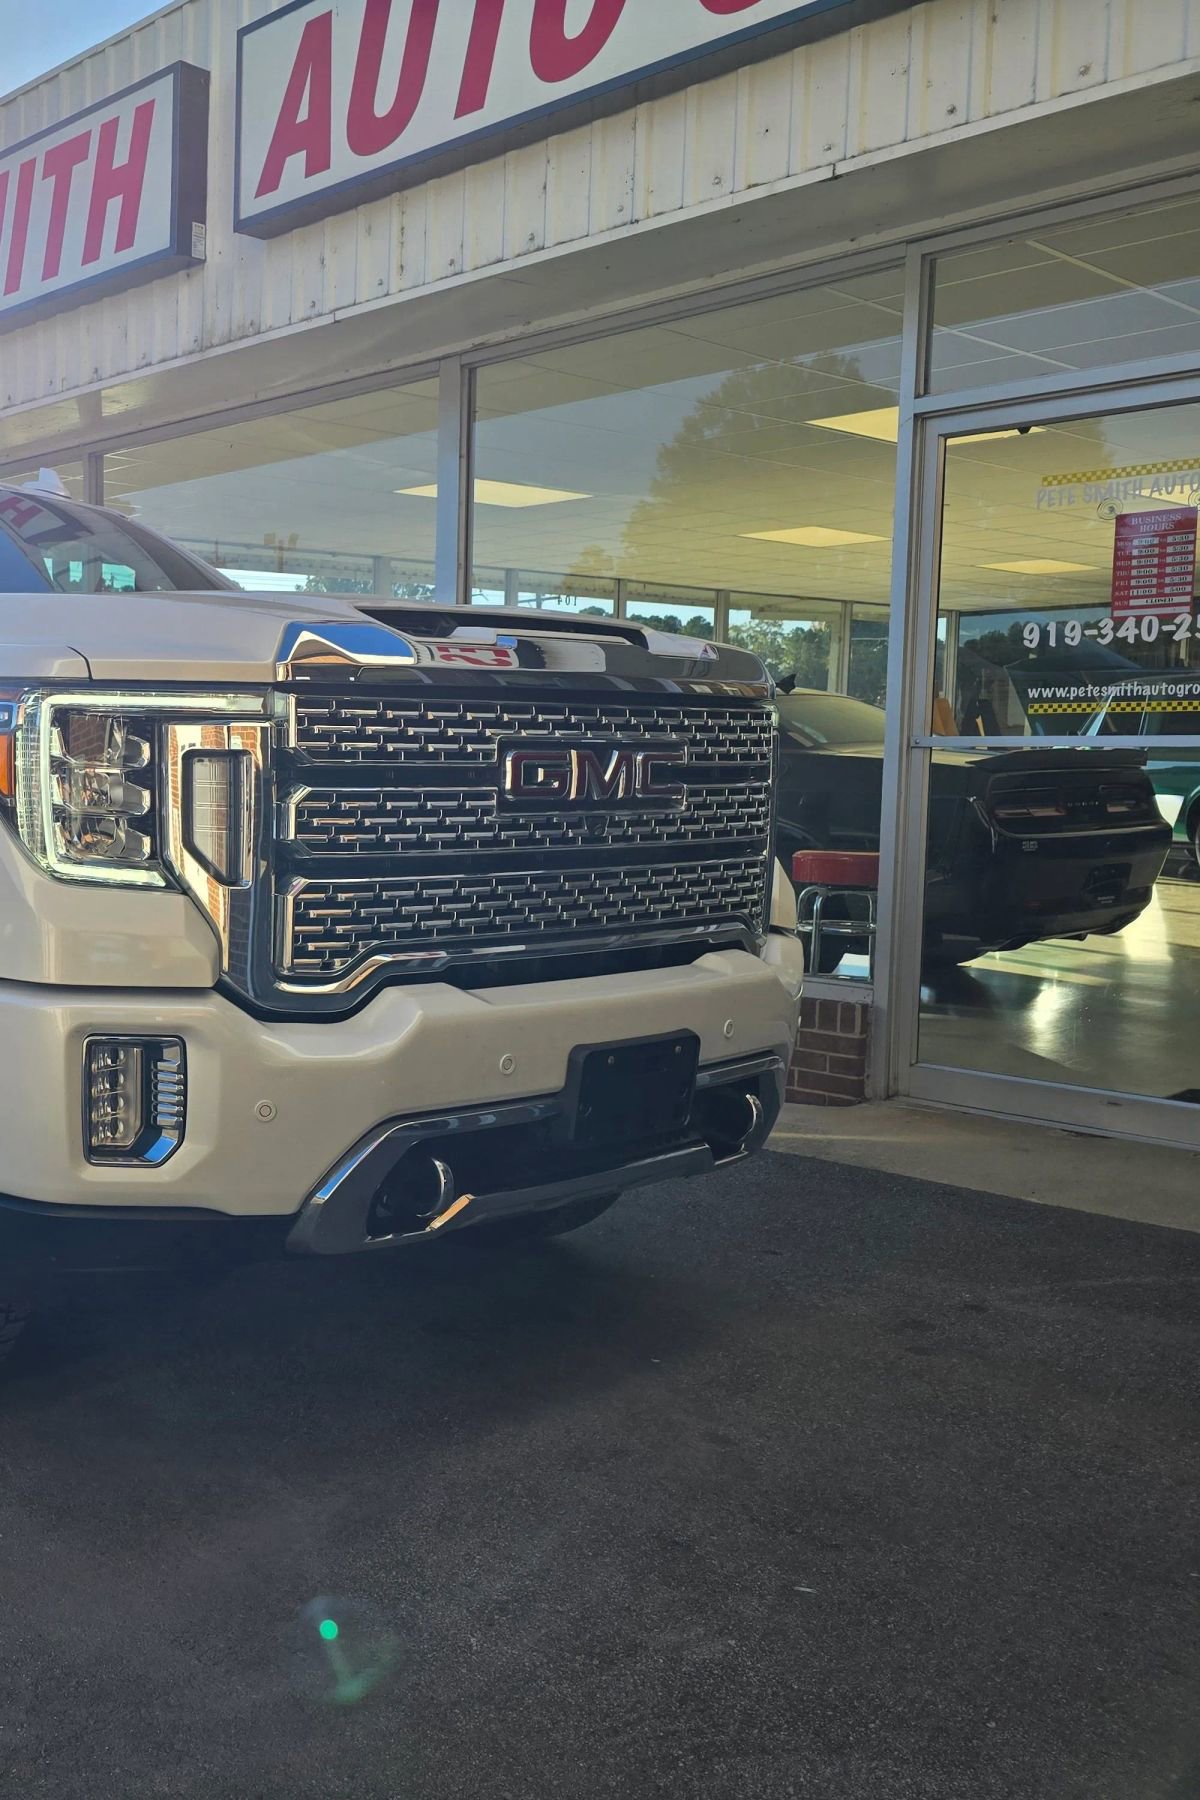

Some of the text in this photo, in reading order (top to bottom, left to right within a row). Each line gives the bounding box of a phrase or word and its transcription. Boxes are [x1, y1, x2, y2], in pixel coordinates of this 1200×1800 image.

[1036, 484, 1075, 510] PETE
[1084, 478, 1143, 503] SMITH
[1131, 513, 1182, 526] BUSINESS
[1139, 522, 1175, 533] HOURS
[1027, 681, 1200, 700] www.petesmithautogro
[504, 749, 686, 800] GMC
